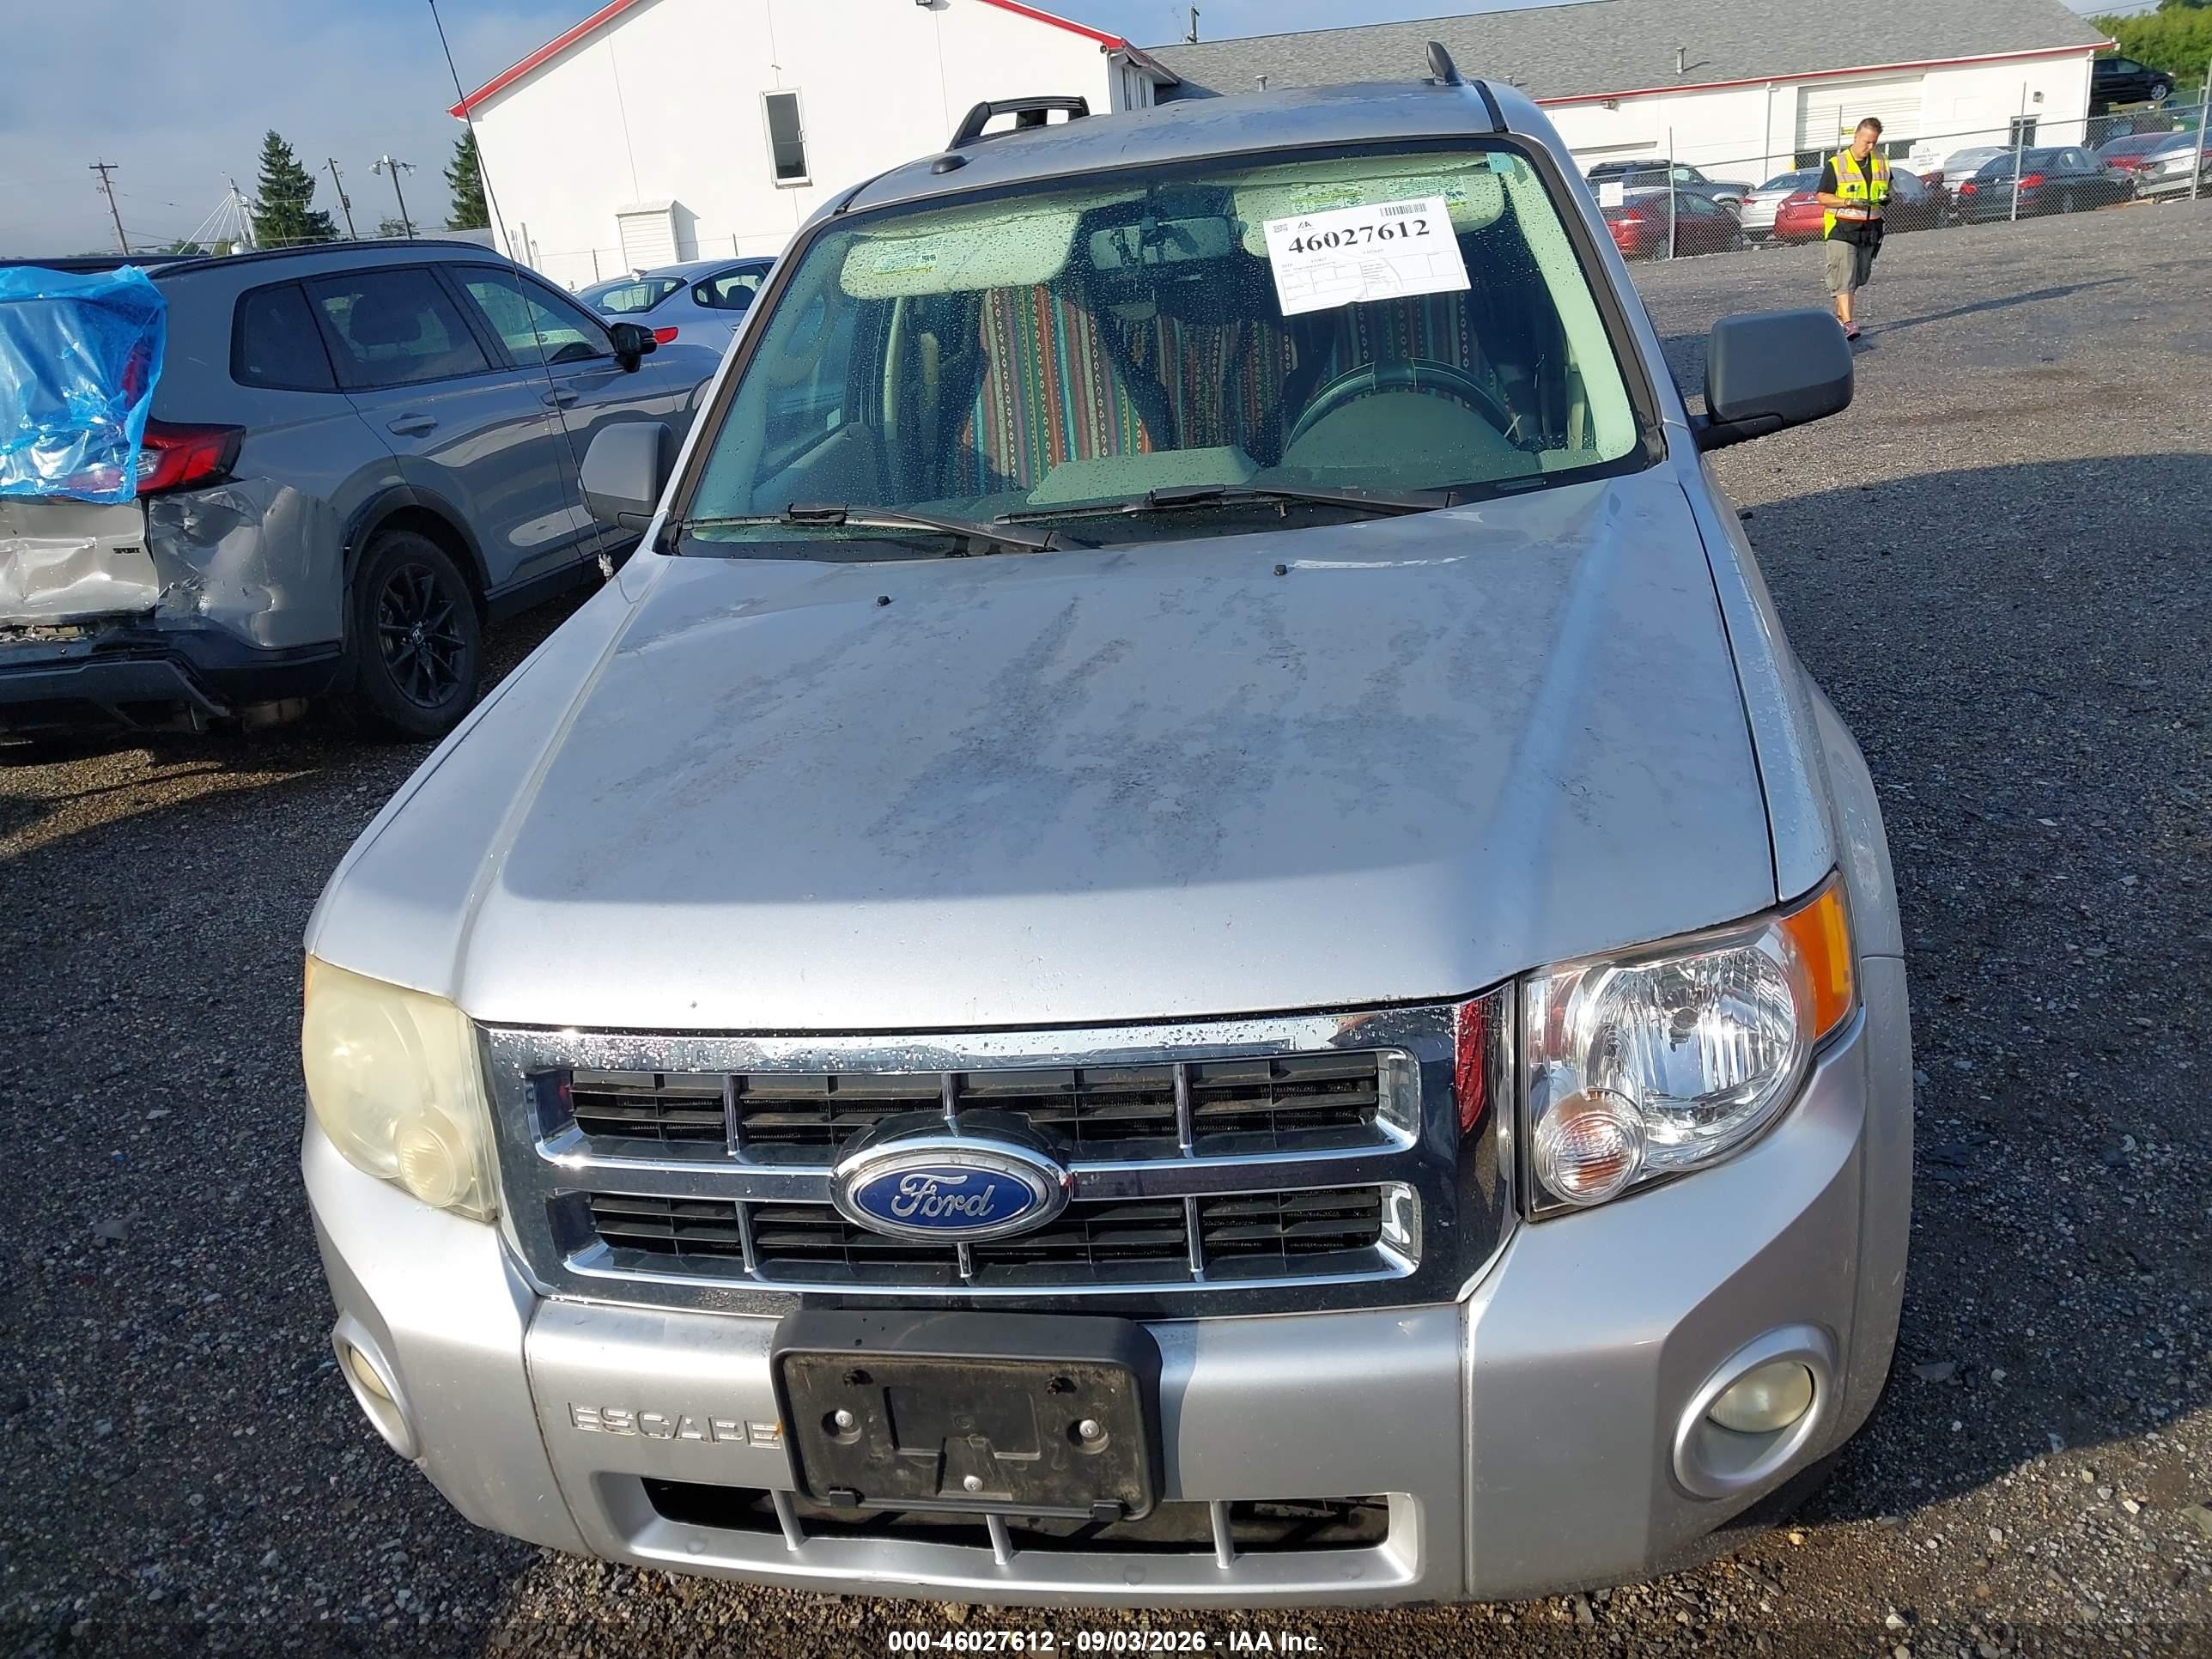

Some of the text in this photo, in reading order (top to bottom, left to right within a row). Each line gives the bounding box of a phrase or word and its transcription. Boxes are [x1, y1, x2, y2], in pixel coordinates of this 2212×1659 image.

[1288, 219, 1430, 254] 46027612
[890, 1173, 995, 1217] Ford
[567, 1401, 781, 1449] ESCAPE
